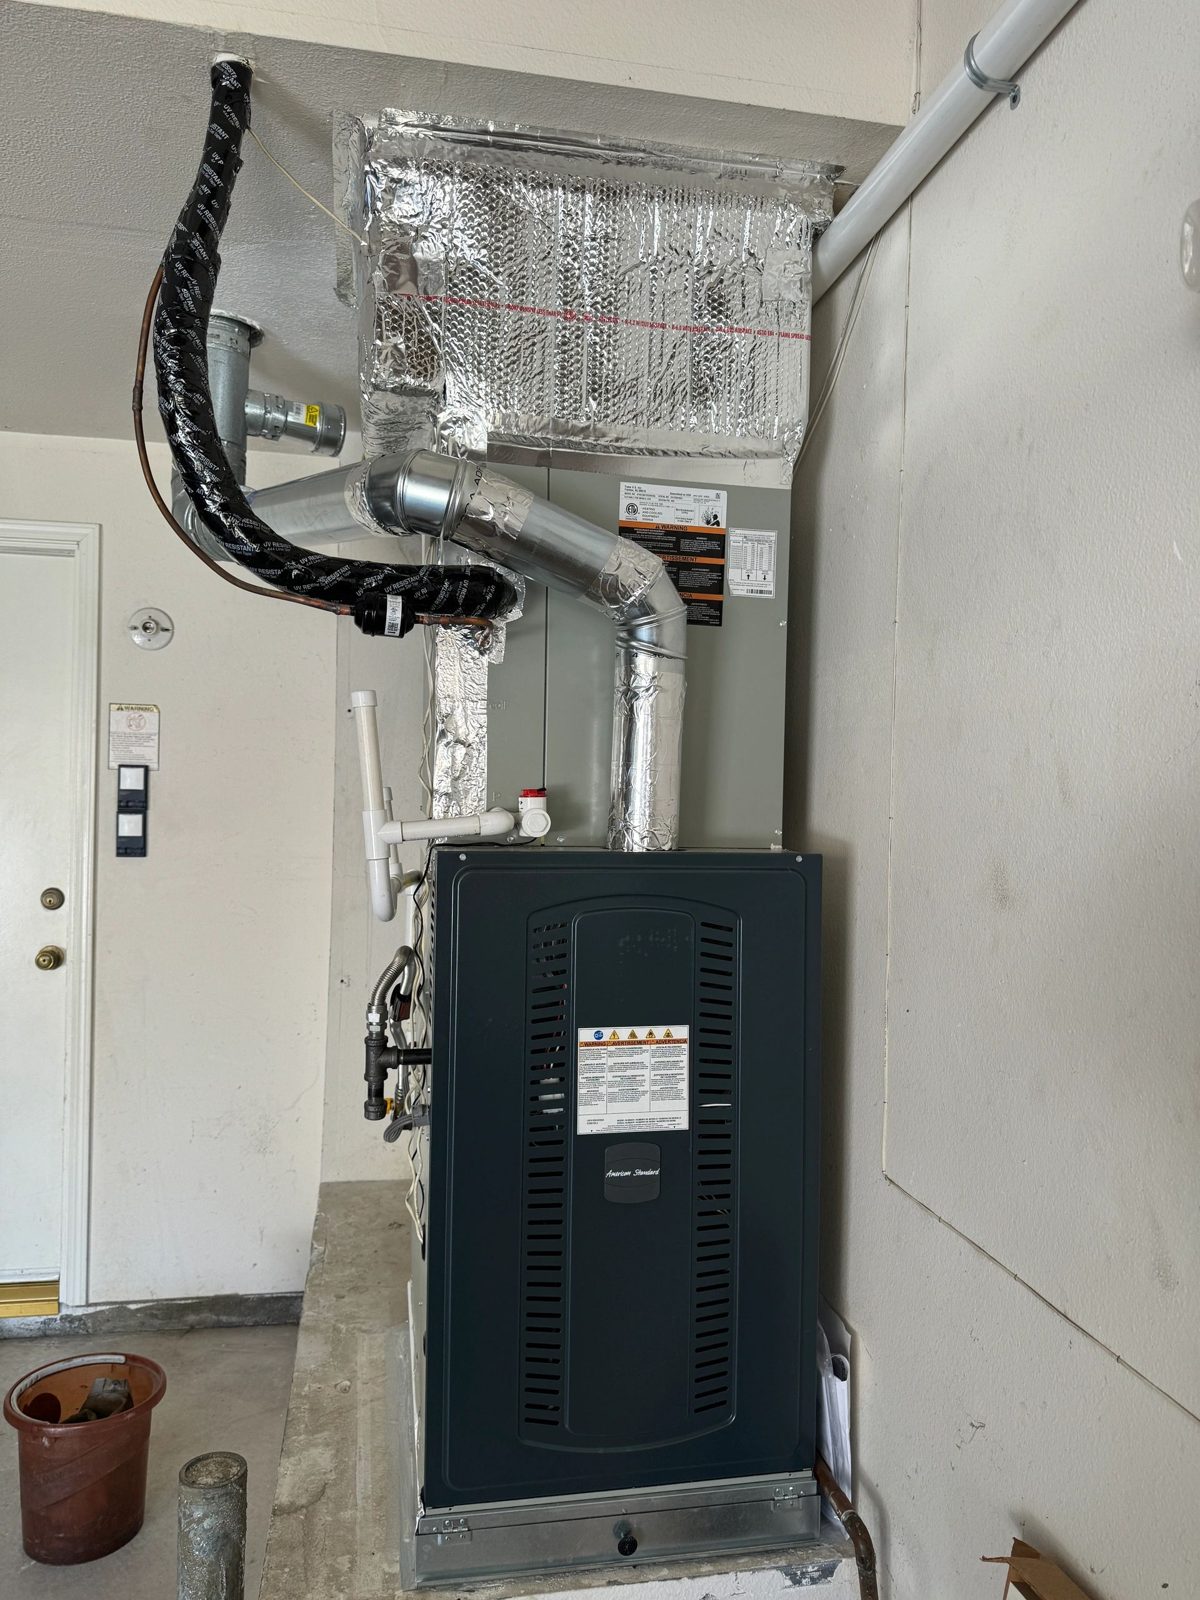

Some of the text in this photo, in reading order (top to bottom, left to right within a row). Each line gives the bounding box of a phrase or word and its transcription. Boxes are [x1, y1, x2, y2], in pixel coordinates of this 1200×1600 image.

[174, 261, 184, 271] UV
[660, 524, 688, 532] WARNING
[299, 556, 308, 565] UV
[658, 554, 697, 563] RTISSEMENT
[384, 586, 393, 594] UV
[655, 1037, 688, 1045] ADVERTENCIA
[605, 1167, 660, 1178] American Standard
